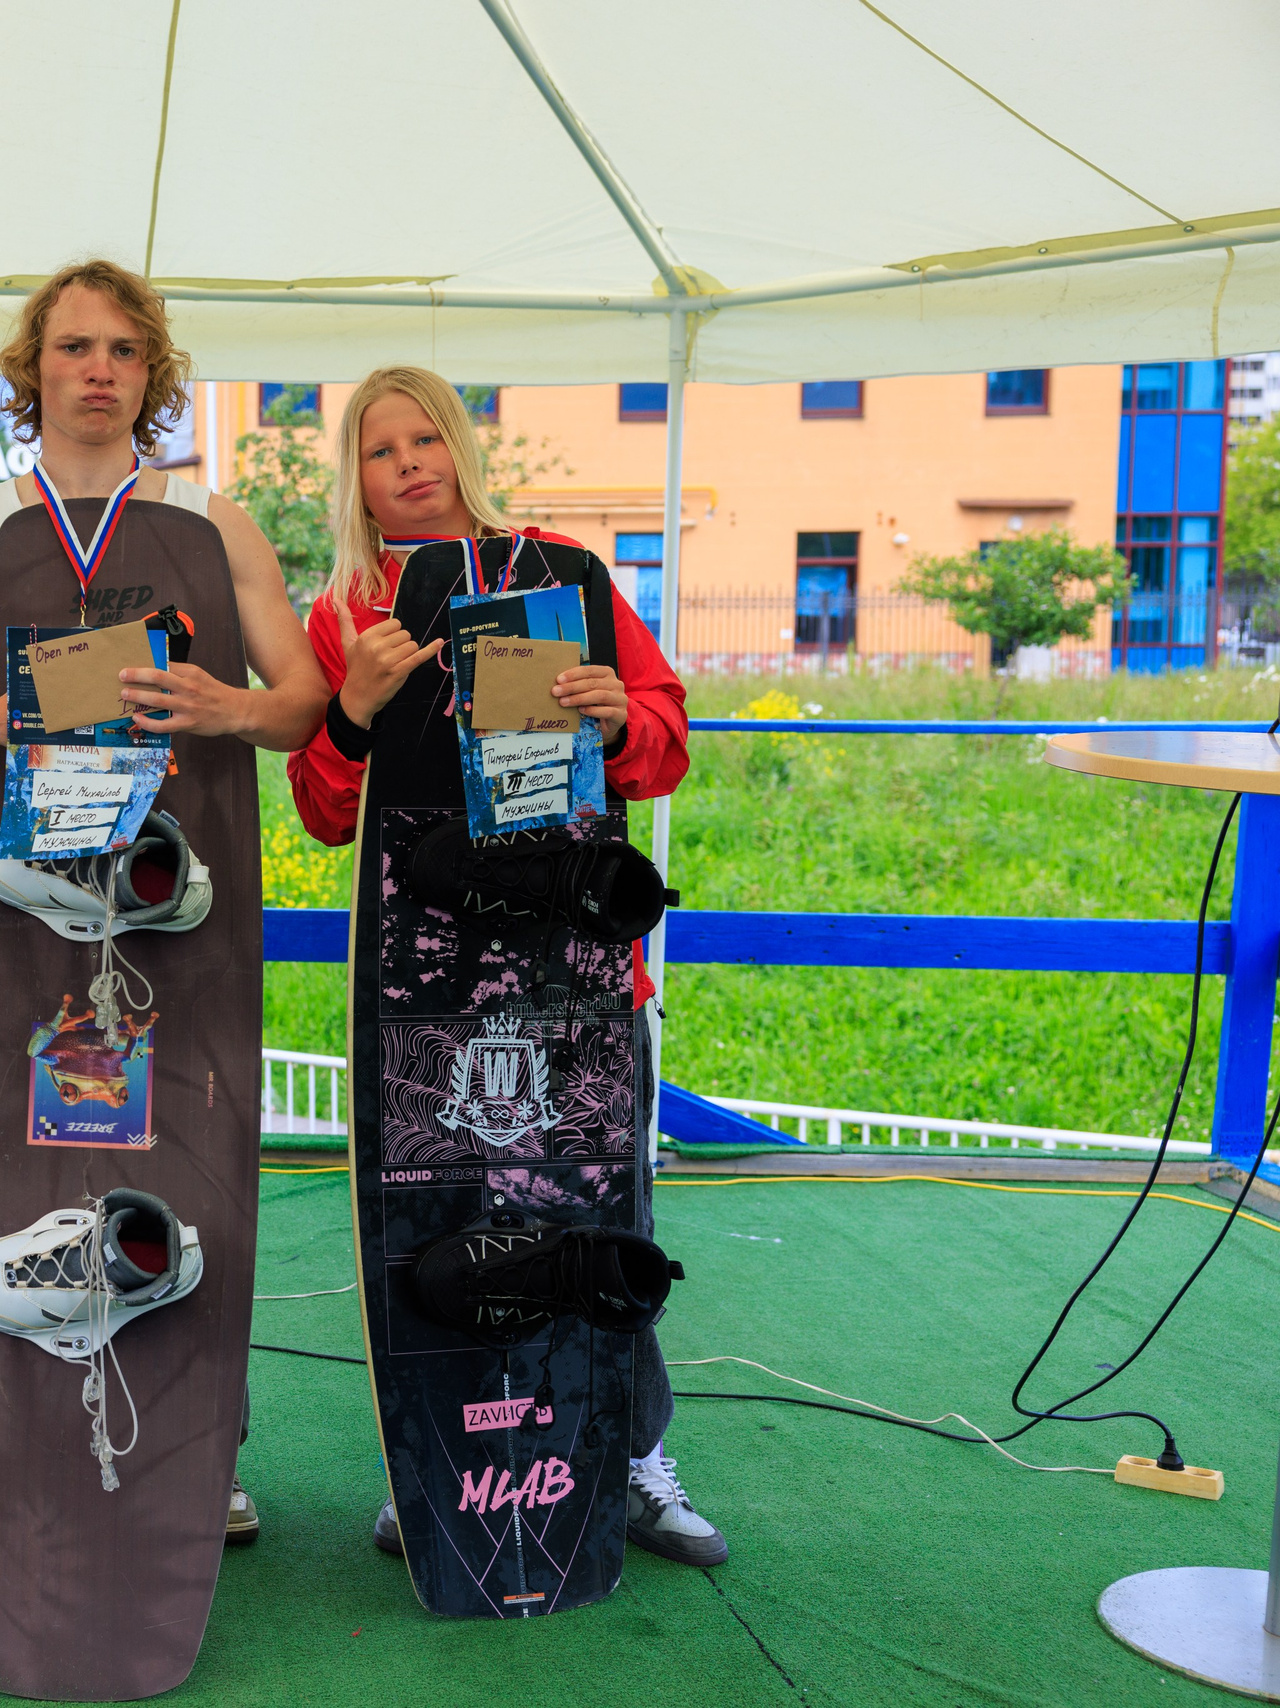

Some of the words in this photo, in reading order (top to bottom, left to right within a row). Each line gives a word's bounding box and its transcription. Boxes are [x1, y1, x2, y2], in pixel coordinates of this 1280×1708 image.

[69, 585, 154, 614] SHRED
[97, 611, 125, 623] AND
[35, 646, 62, 664] Open
[68, 641, 90, 654] men
[484, 640, 509, 660] Open
[511, 646, 534, 658] men
[56, 759, 100, 768] НАГРАЖДАЕТСЯ
[483, 747, 522, 767] Тимофей
[36, 782, 73, 800] Сергей
[75, 786, 121, 798] Михайлов
[594, 992, 621, 1011] 140
[64, 1121, 120, 1135] BREEZE
[381, 1168, 483, 1184] LIQUIDFORCE
[458, 1456, 576, 1515] MLAB
